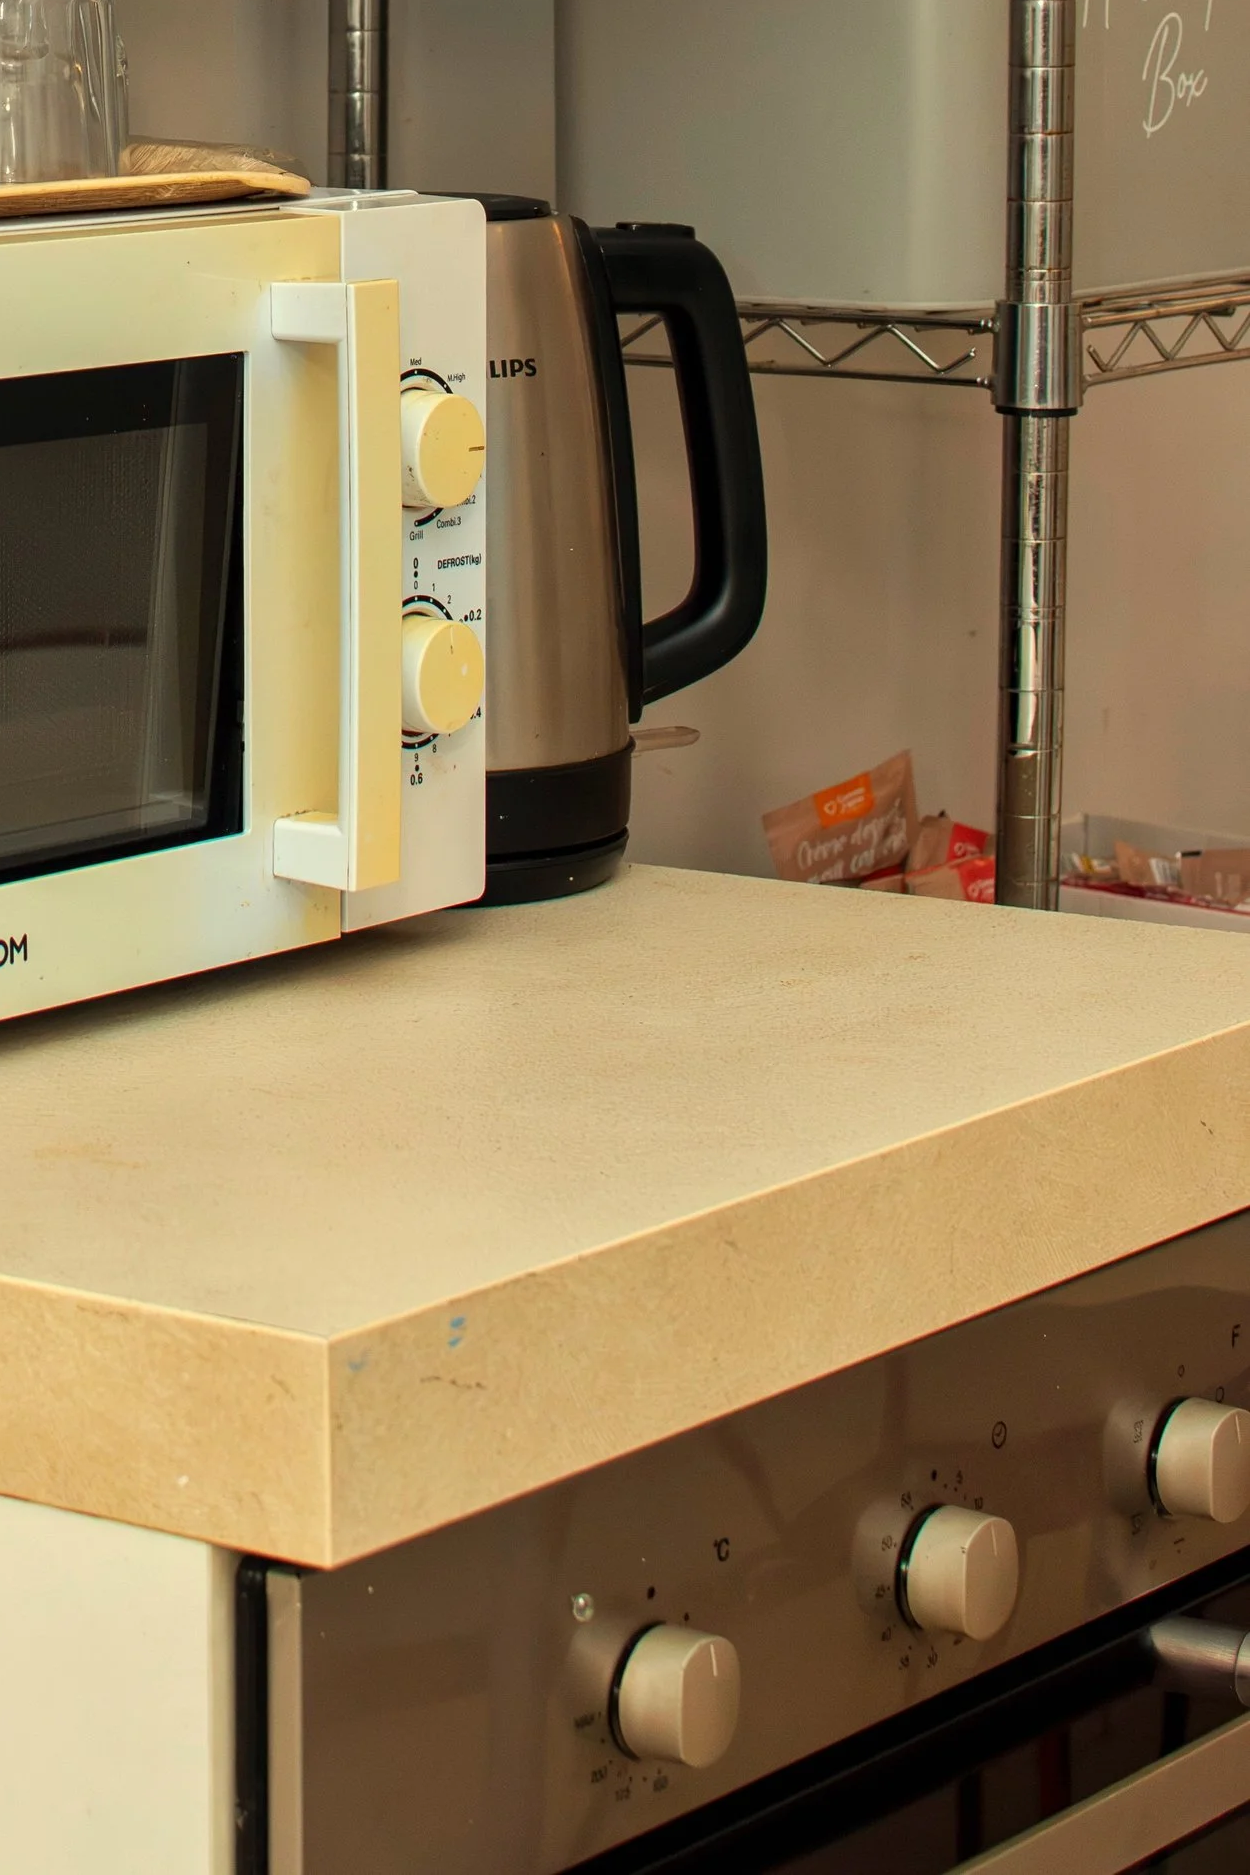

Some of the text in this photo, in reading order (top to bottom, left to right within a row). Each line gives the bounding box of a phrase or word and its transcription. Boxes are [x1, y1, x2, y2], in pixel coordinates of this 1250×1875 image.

[1141, 11, 1209, 139] Box
[410, 357, 422, 366] Med
[488, 358, 537, 379] LIPS
[436, 516, 462, 529] Combi.3
[409, 530, 424, 541] Grill
[437, 553, 482, 570] DEFROST(kg)
[410, 772, 423, 786] 0.6
